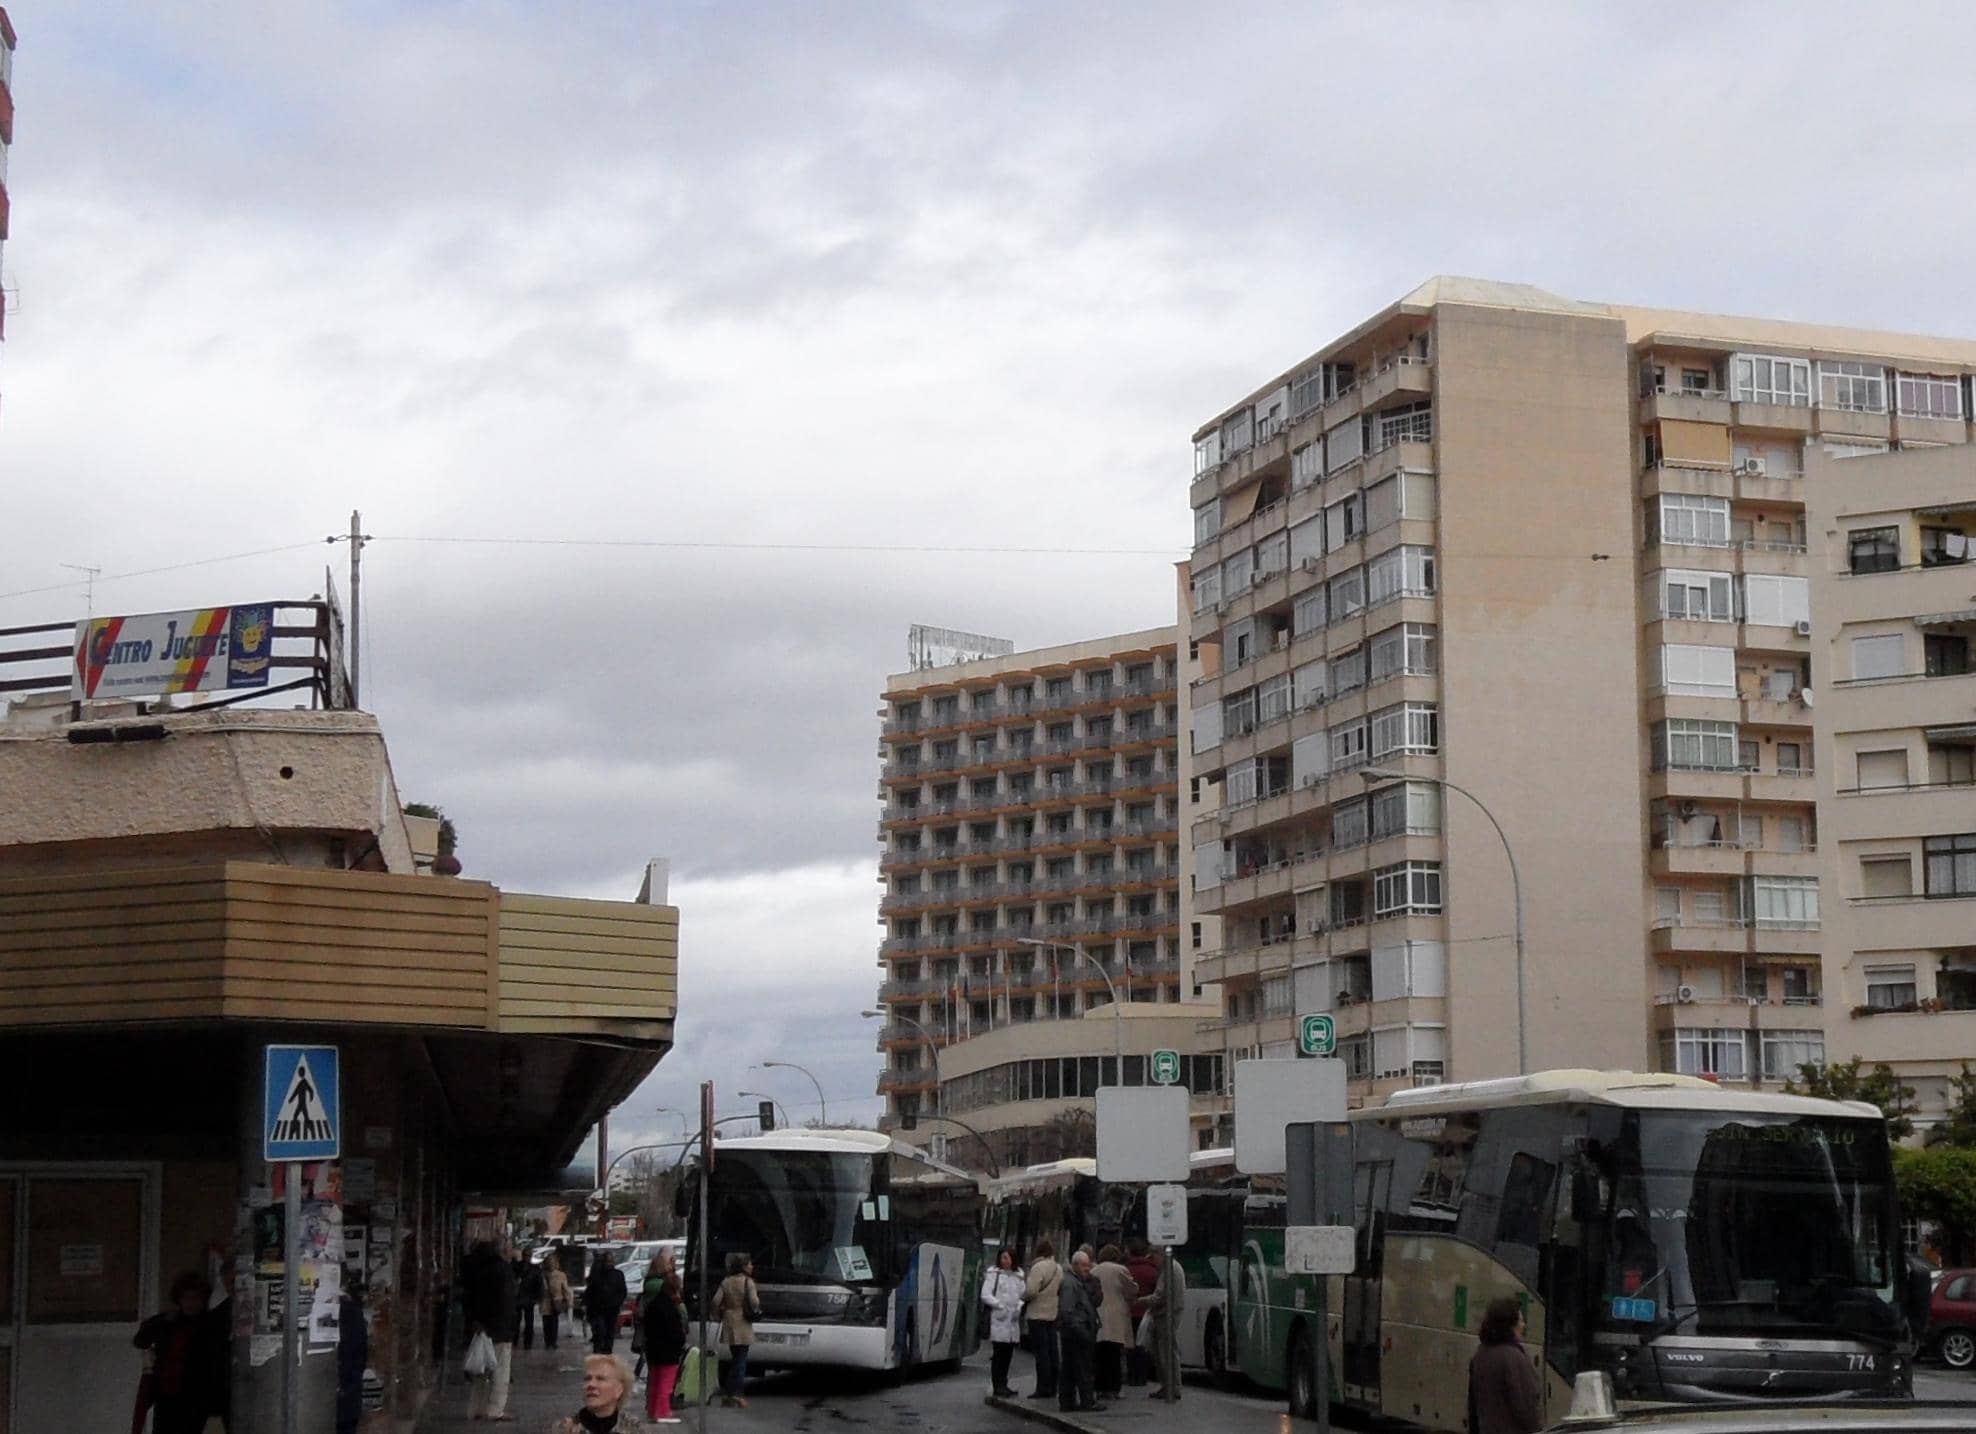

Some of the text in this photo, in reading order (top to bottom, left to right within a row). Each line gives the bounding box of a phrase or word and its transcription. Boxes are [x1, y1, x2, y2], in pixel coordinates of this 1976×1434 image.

[90, 627, 153, 665] CENTRO
[1667, 1353, 1704, 1362] VOLVO
[1846, 1354, 1875, 1371] 774
